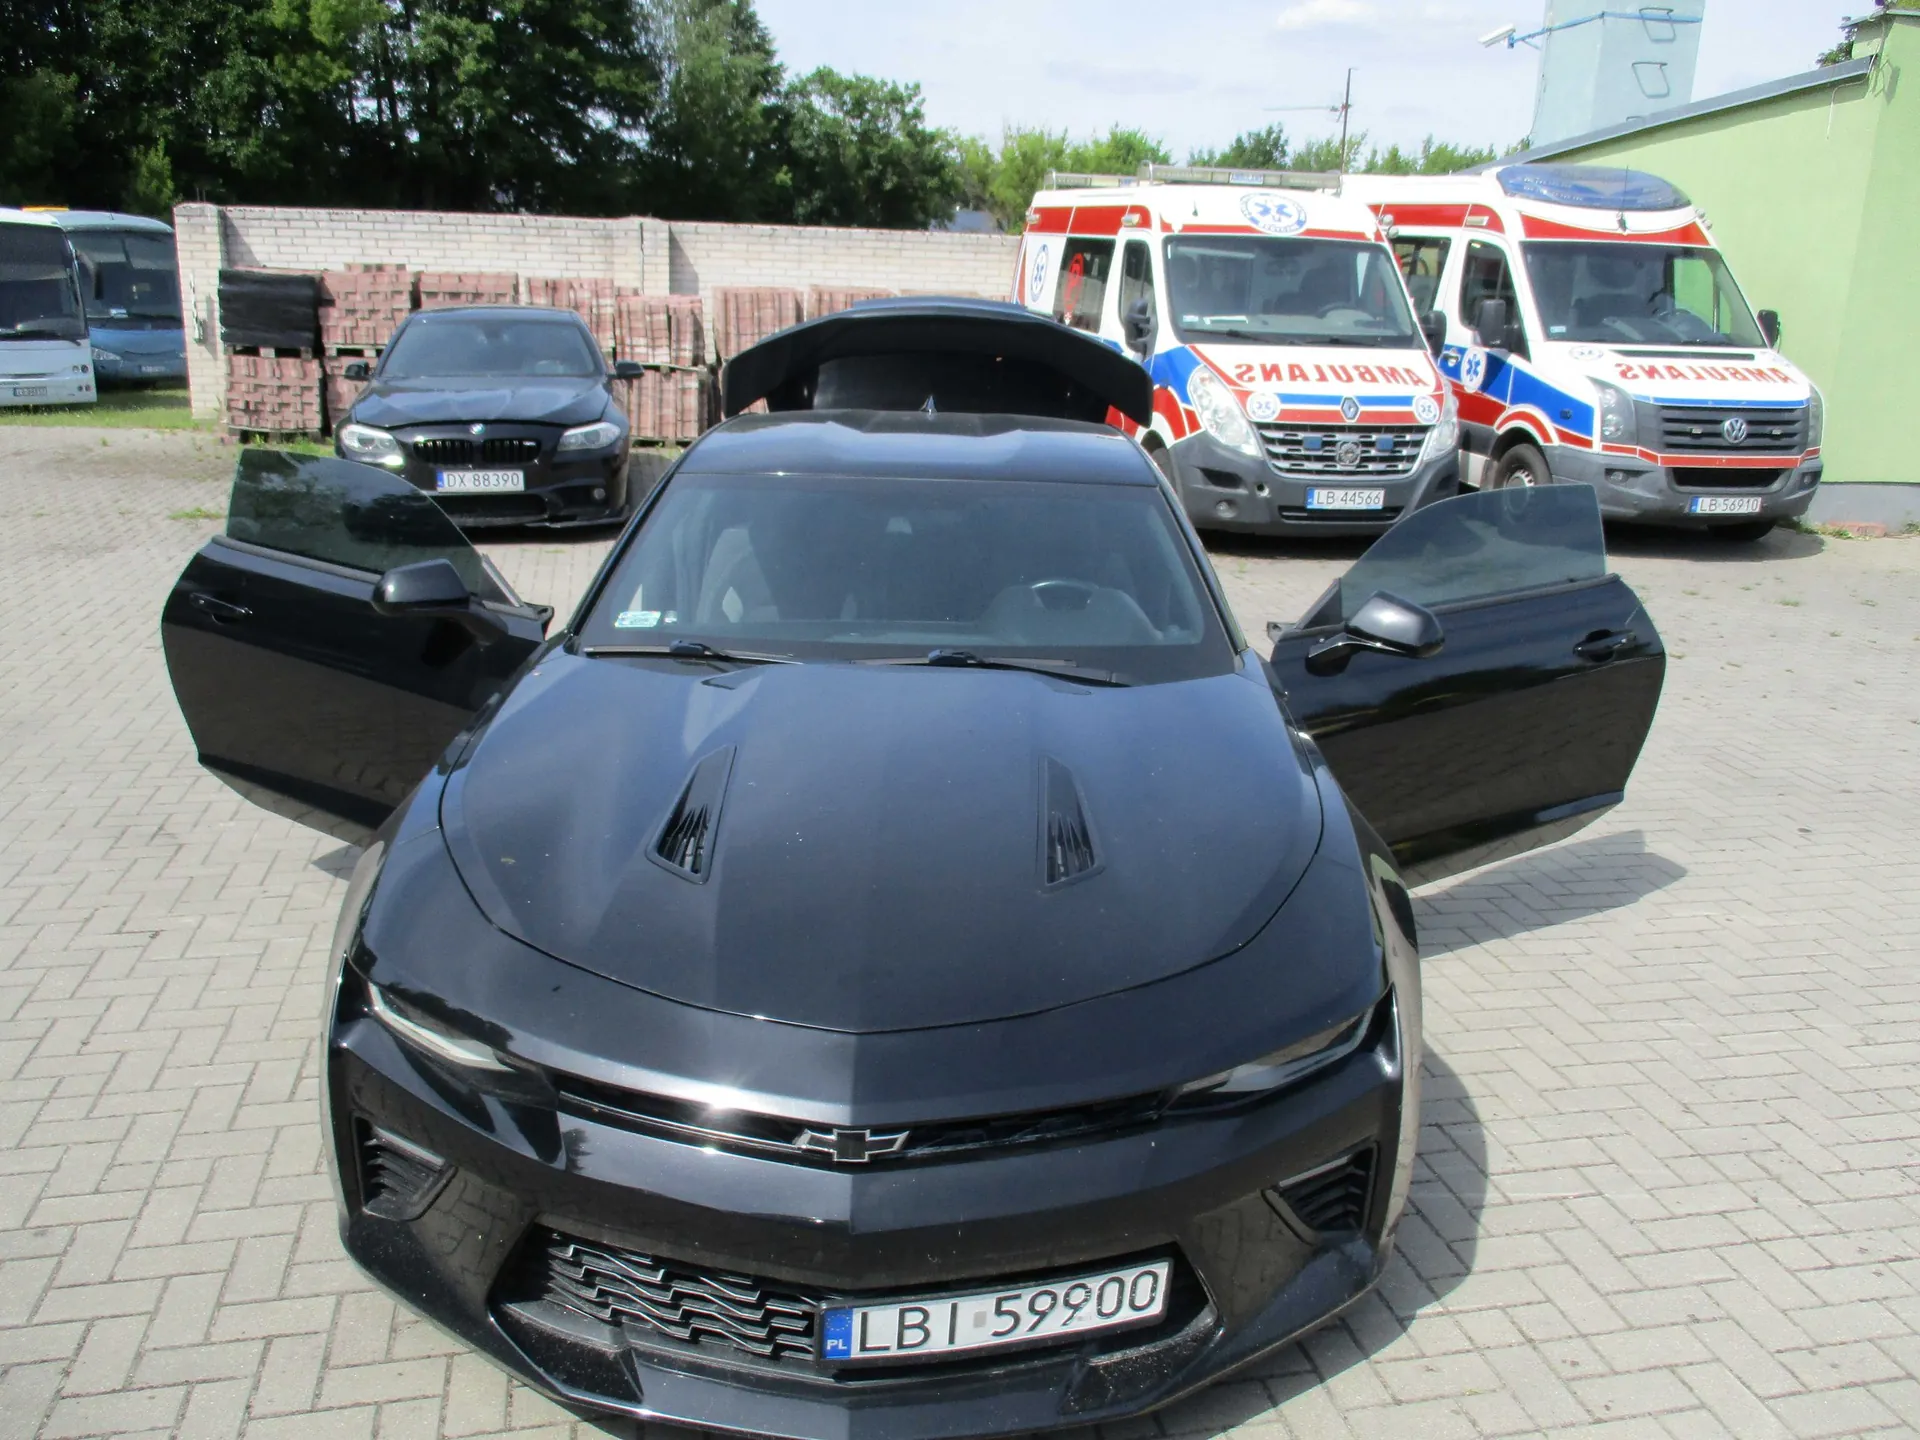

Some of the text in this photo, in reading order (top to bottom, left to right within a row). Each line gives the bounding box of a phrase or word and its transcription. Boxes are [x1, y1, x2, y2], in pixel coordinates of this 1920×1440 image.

[446, 473, 467, 487] DX
[472, 473, 520, 487] 88390
[1316, 491, 1381, 505] LB 44566
[1700, 499, 1759, 511] LB 56910
[859, 1269, 1160, 1352] LBI 59900
[826, 1338, 848, 1350] PL
